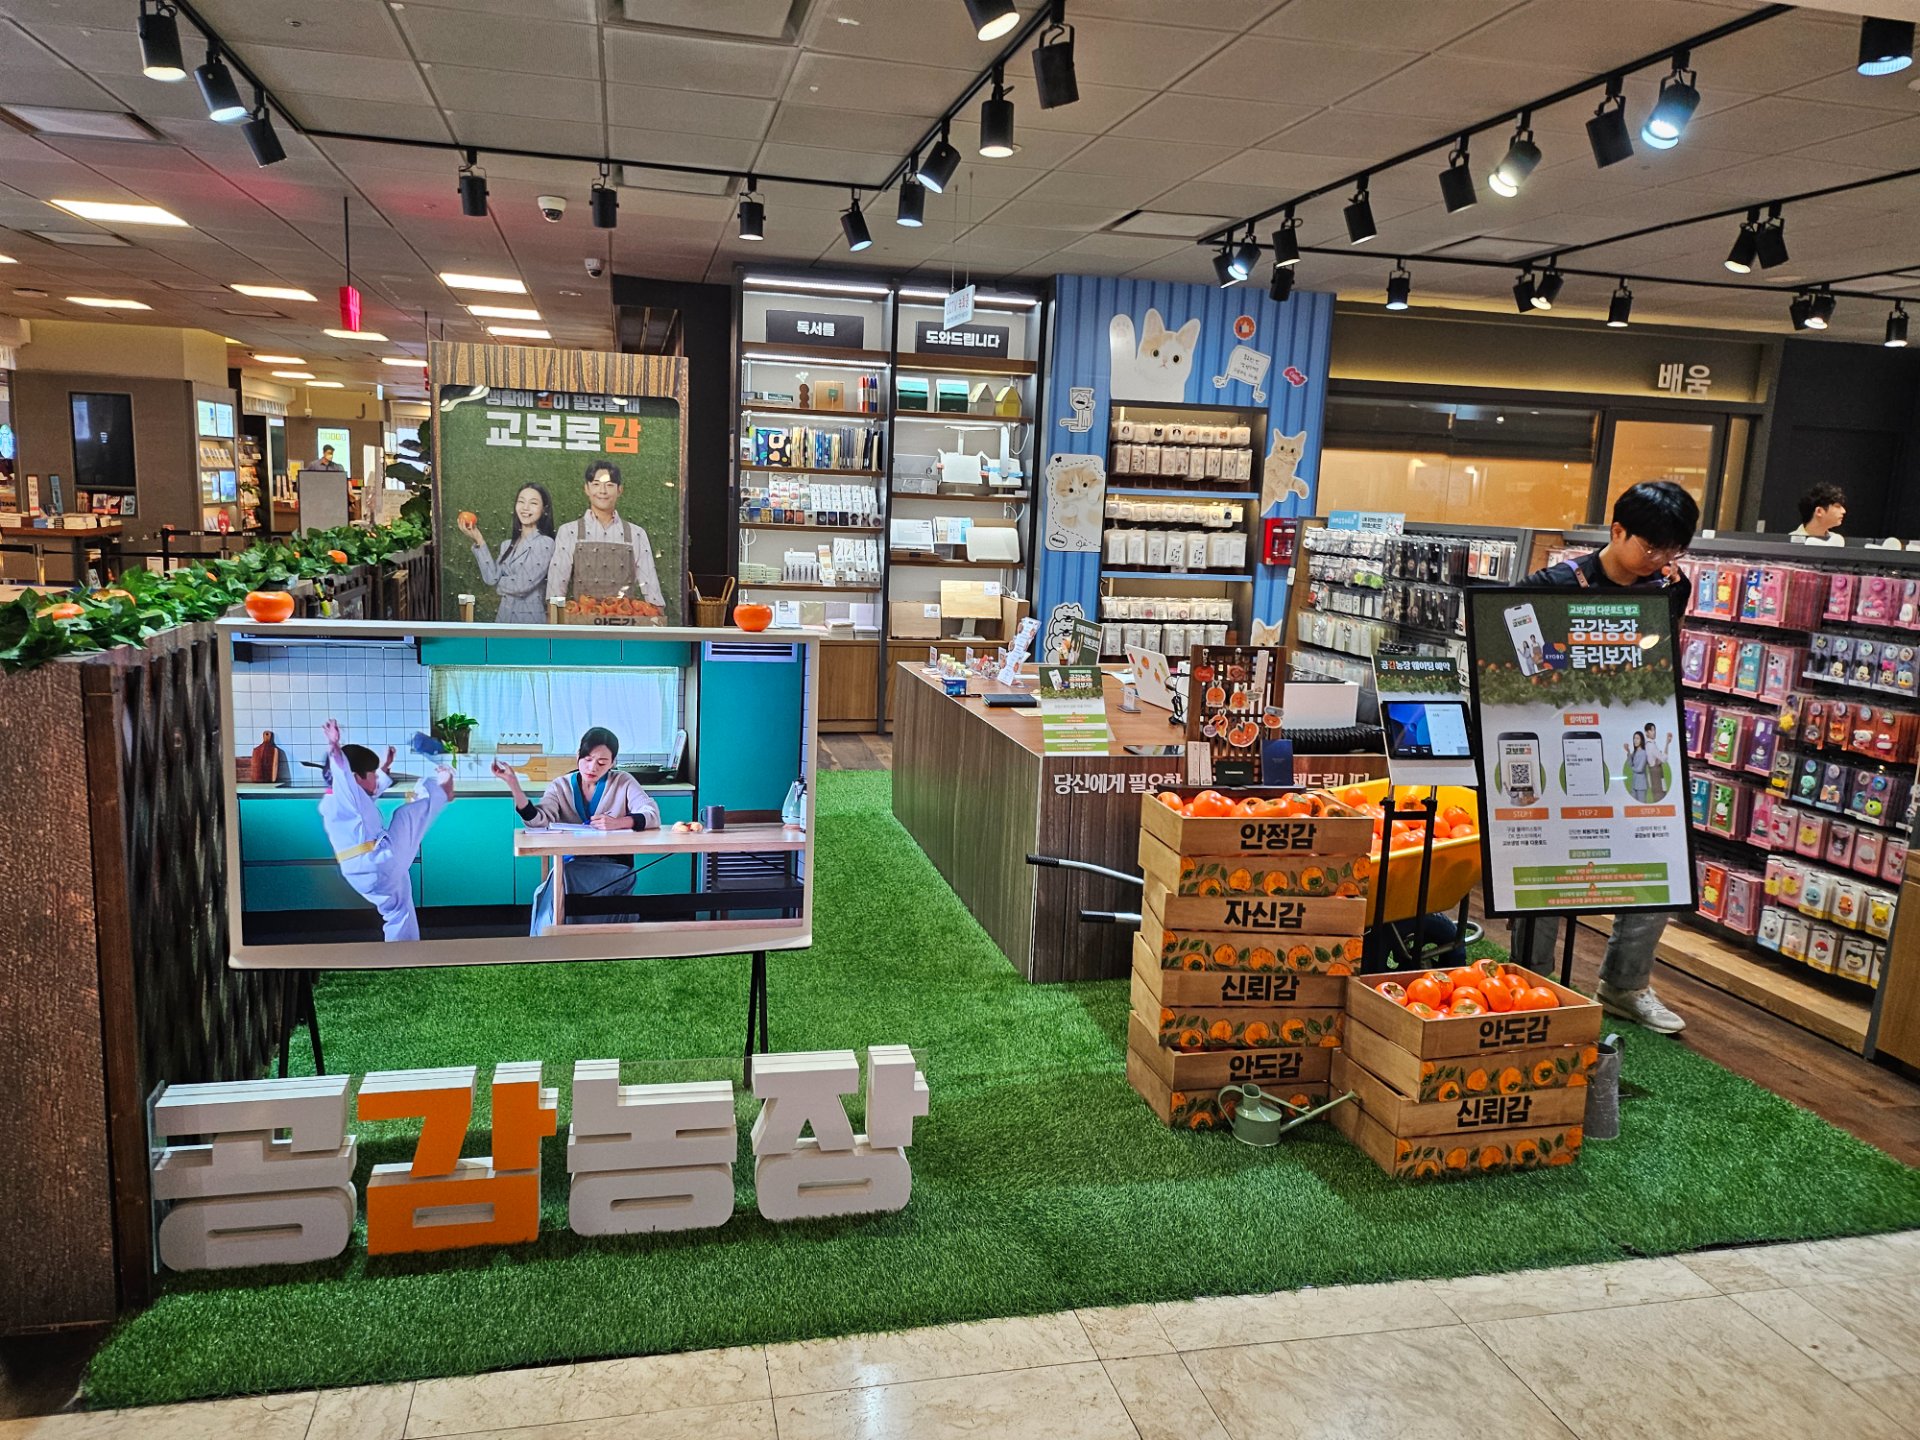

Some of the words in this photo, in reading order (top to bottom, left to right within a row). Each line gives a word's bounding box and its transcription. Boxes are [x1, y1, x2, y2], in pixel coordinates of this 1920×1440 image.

[796, 320, 836, 337] 독서를
[925, 330, 1001, 349] 도와드립니다
[1657, 363, 1712, 400] 배움
[485, 411, 642, 454] 교보로감
[1569, 605, 1596, 615] 교보생명
[1596, 605, 1623, 615] 다운로드
[1569, 619, 1639, 641] 공감농장
[1381, 660, 1411, 671] 공감농장
[1412, 661, 1434, 671] 웨이팅
[1435, 661, 1451, 671] 예약
[1569, 645, 1643, 669] 둘러보자!
[1053, 773, 1126, 794] 당신에게
[1240, 822, 1317, 850] 안정감
[1223, 899, 1307, 929] 자신감
[1221, 975, 1300, 1002] 신뢰감
[1478, 1015, 1552, 1049] 안도감
[1228, 1052, 1304, 1082] 안도감
[1456, 1095, 1533, 1129] 신뢰감
[153, 1045, 931, 1272] 공감농장
